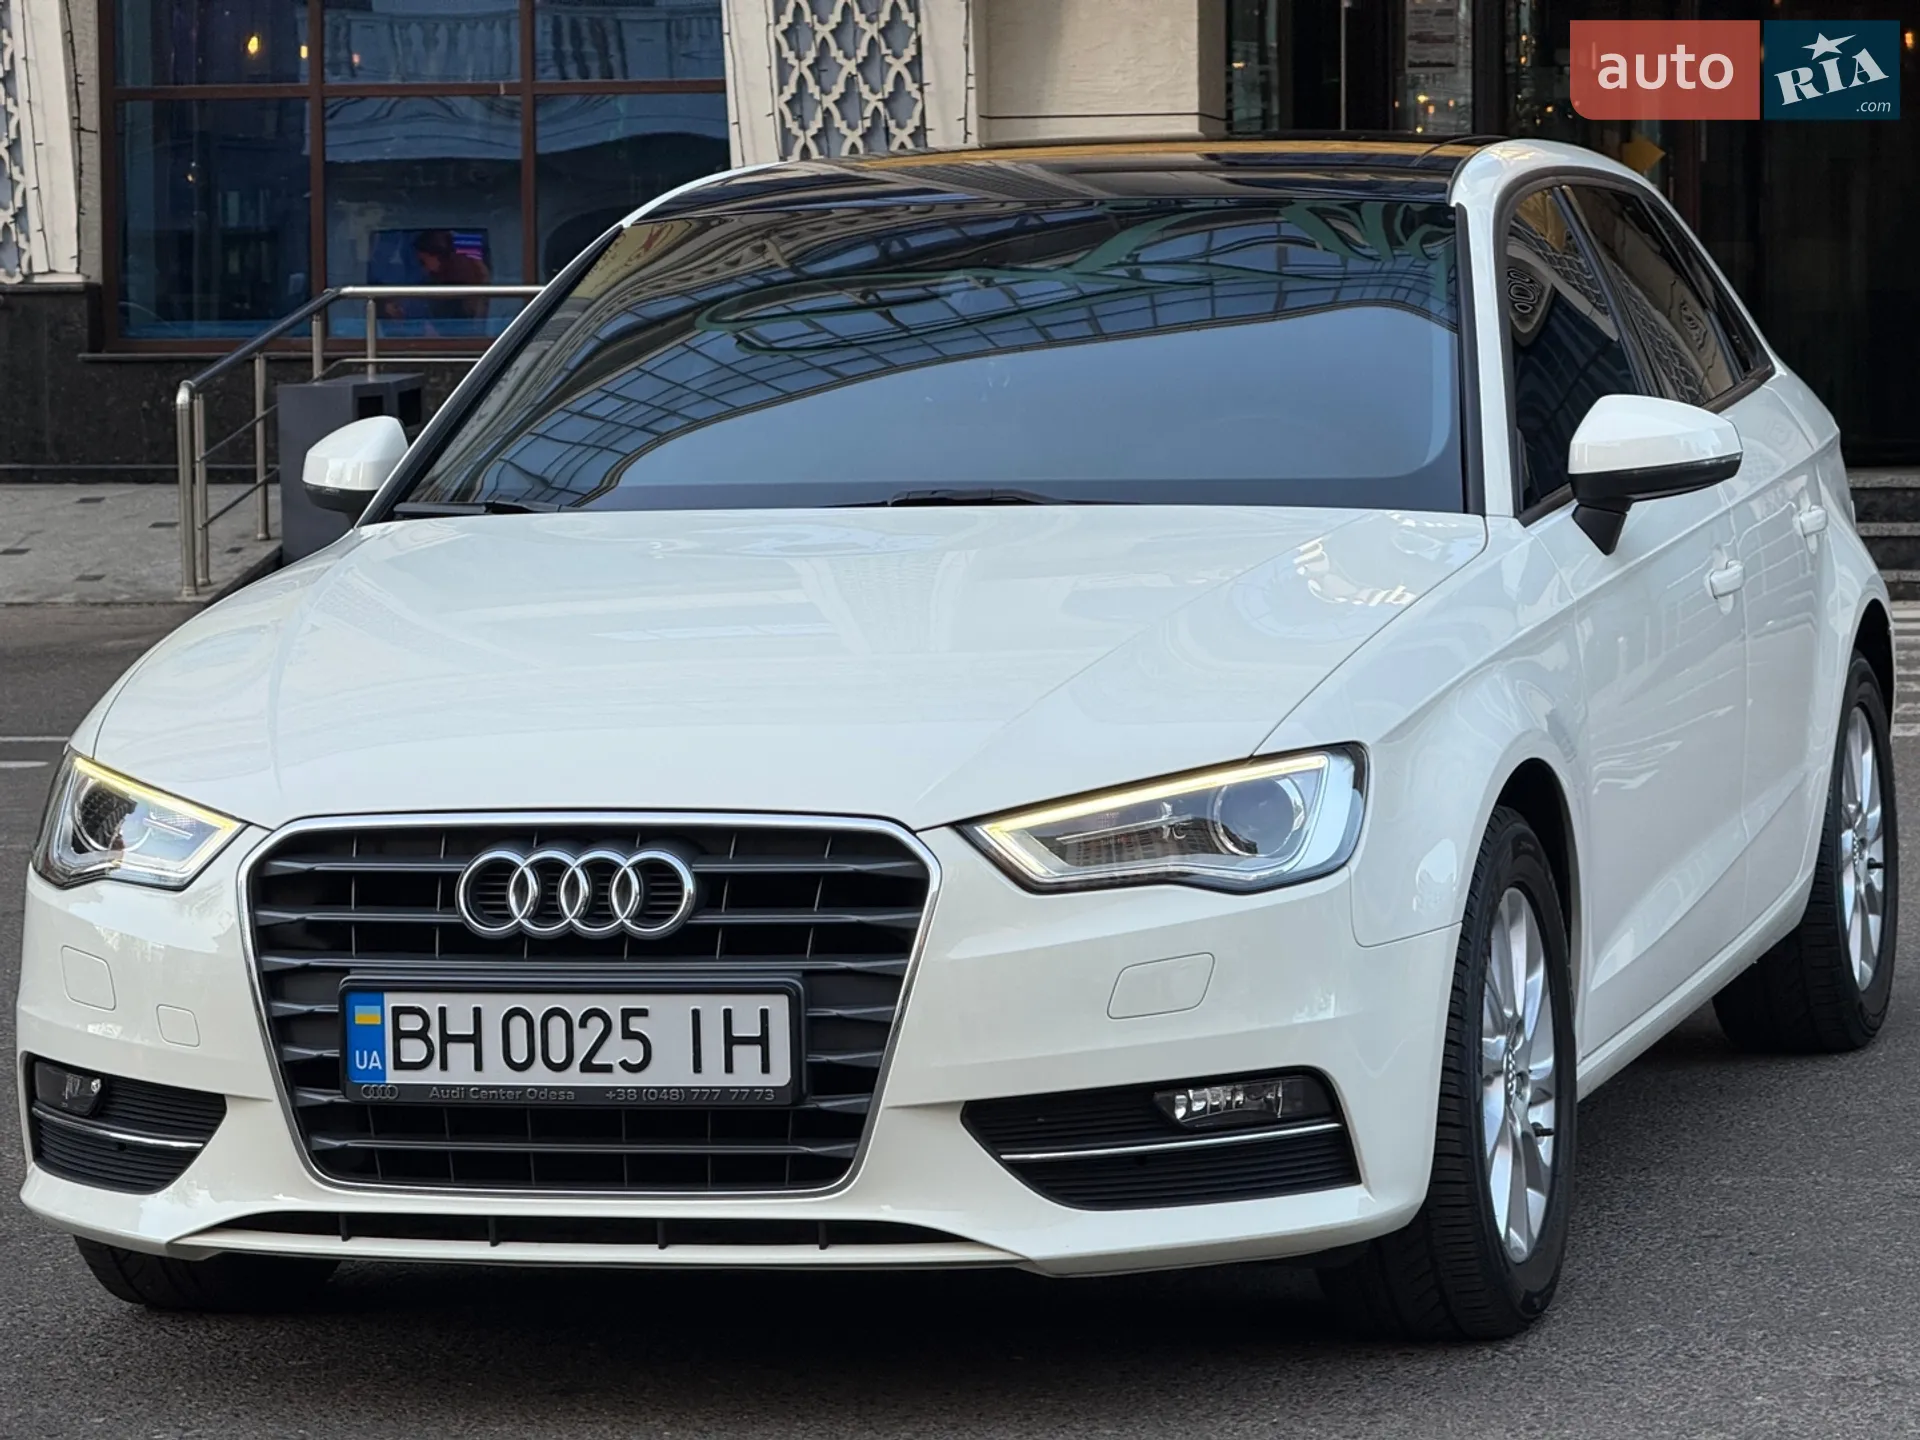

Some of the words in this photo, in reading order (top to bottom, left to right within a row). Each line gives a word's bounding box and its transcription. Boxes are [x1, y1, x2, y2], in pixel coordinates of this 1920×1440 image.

[391, 1005, 483, 1073] BH
[501, 1006, 652, 1073] 0025
[691, 1007, 771, 1075] IH
[355, 1050, 383, 1070] UA
[429, 1086, 465, 1099] Audi
[469, 1087, 522, 1100] Center
[526, 1088, 575, 1101] Odesa
[605, 1088, 637, 1101] +38
[642, 1087, 685, 1102] (048)
[691, 1089, 721, 1100] 777
